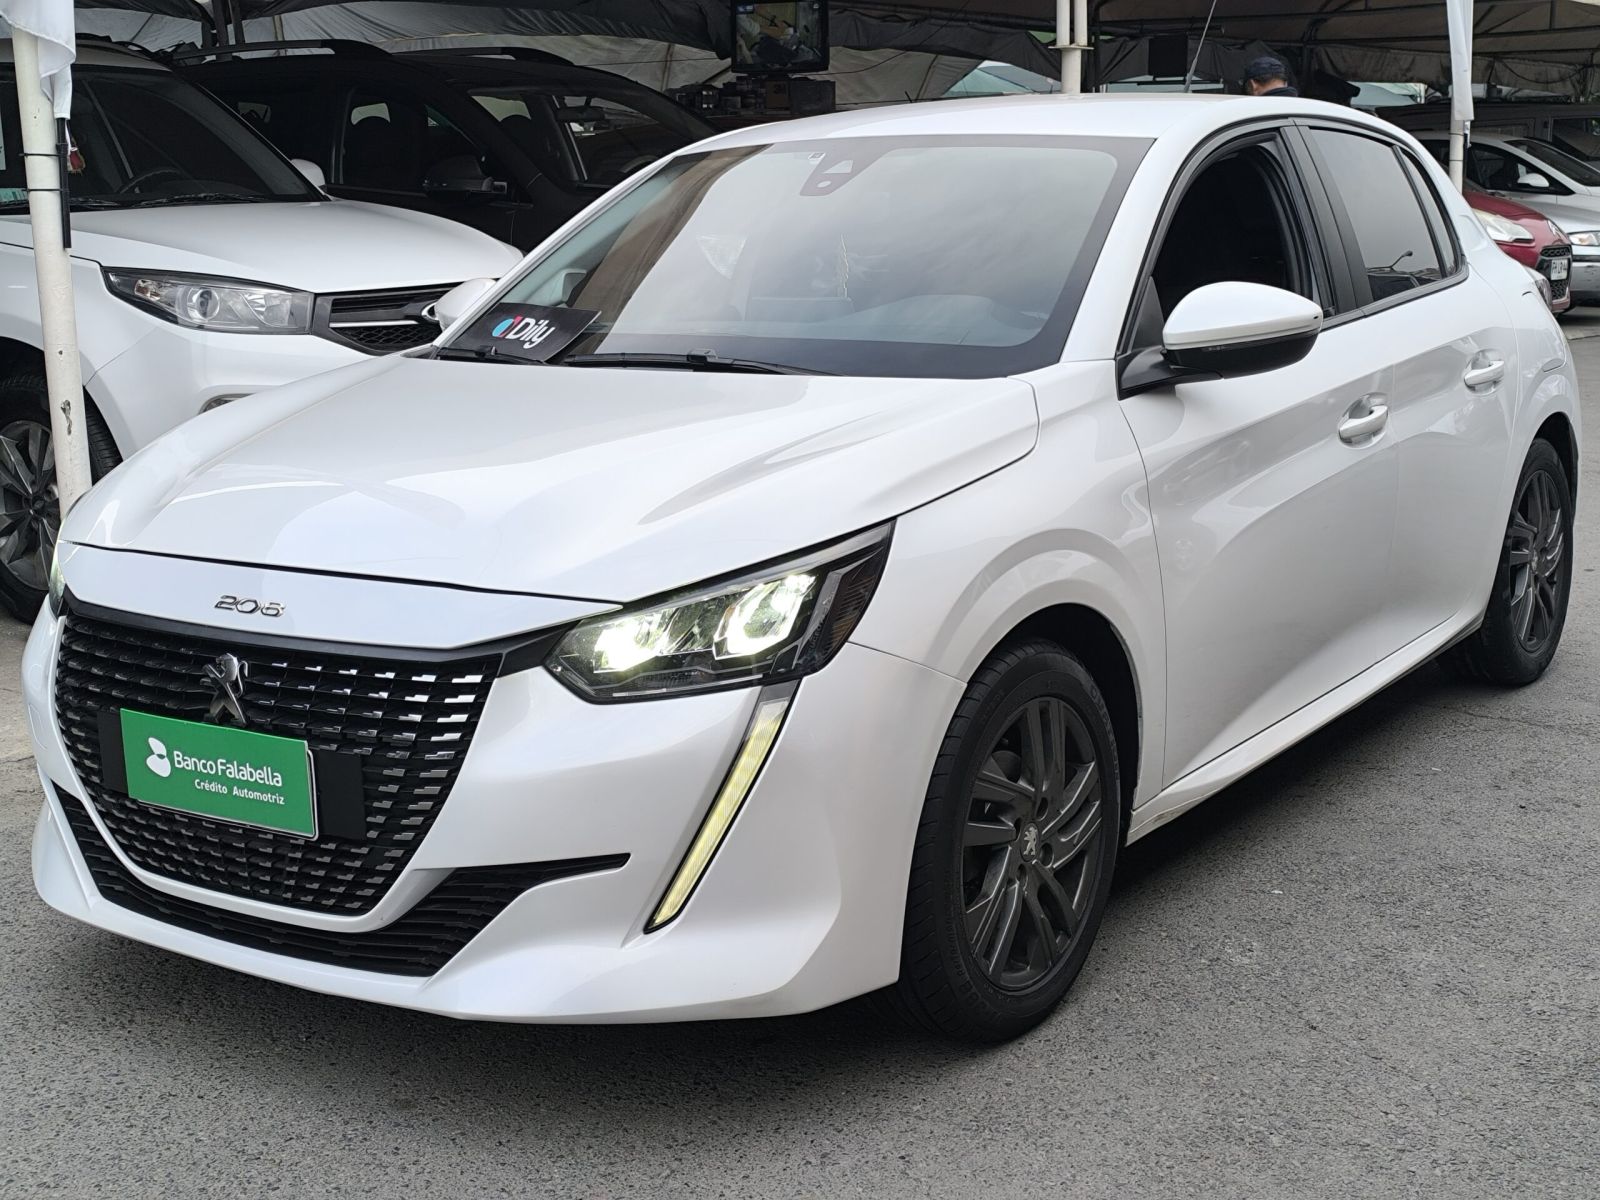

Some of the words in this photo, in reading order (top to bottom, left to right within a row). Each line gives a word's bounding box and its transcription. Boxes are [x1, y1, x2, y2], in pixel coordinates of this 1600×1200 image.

[506, 317, 556, 349] Dily
[195, 779, 228, 794] Crédito
[233, 786, 286, 805] Automotriz
